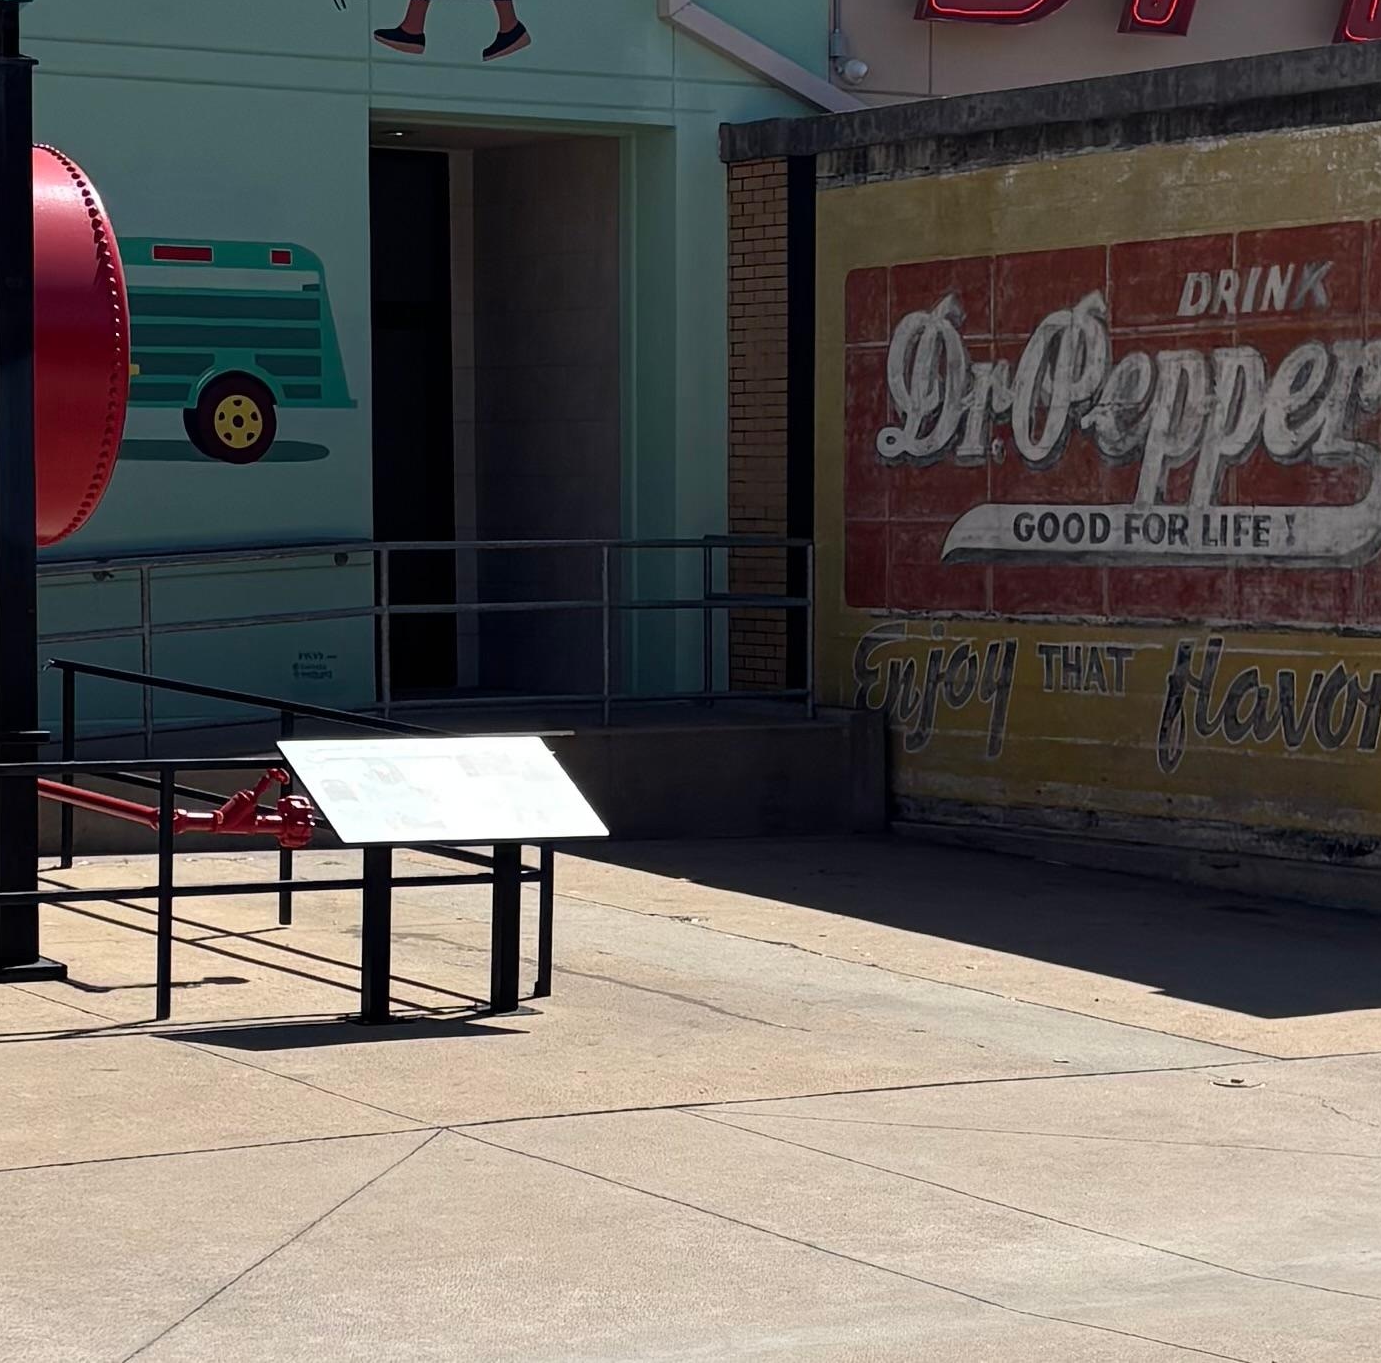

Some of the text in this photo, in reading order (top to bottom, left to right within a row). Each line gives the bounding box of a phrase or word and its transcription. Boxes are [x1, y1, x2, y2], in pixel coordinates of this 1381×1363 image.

[1176, 260, 1335, 317] DRINK
[1013, 511, 1111, 545] GOOD
[1123, 512, 1190, 546] FOR
[1035, 641, 1136, 696] THAT
